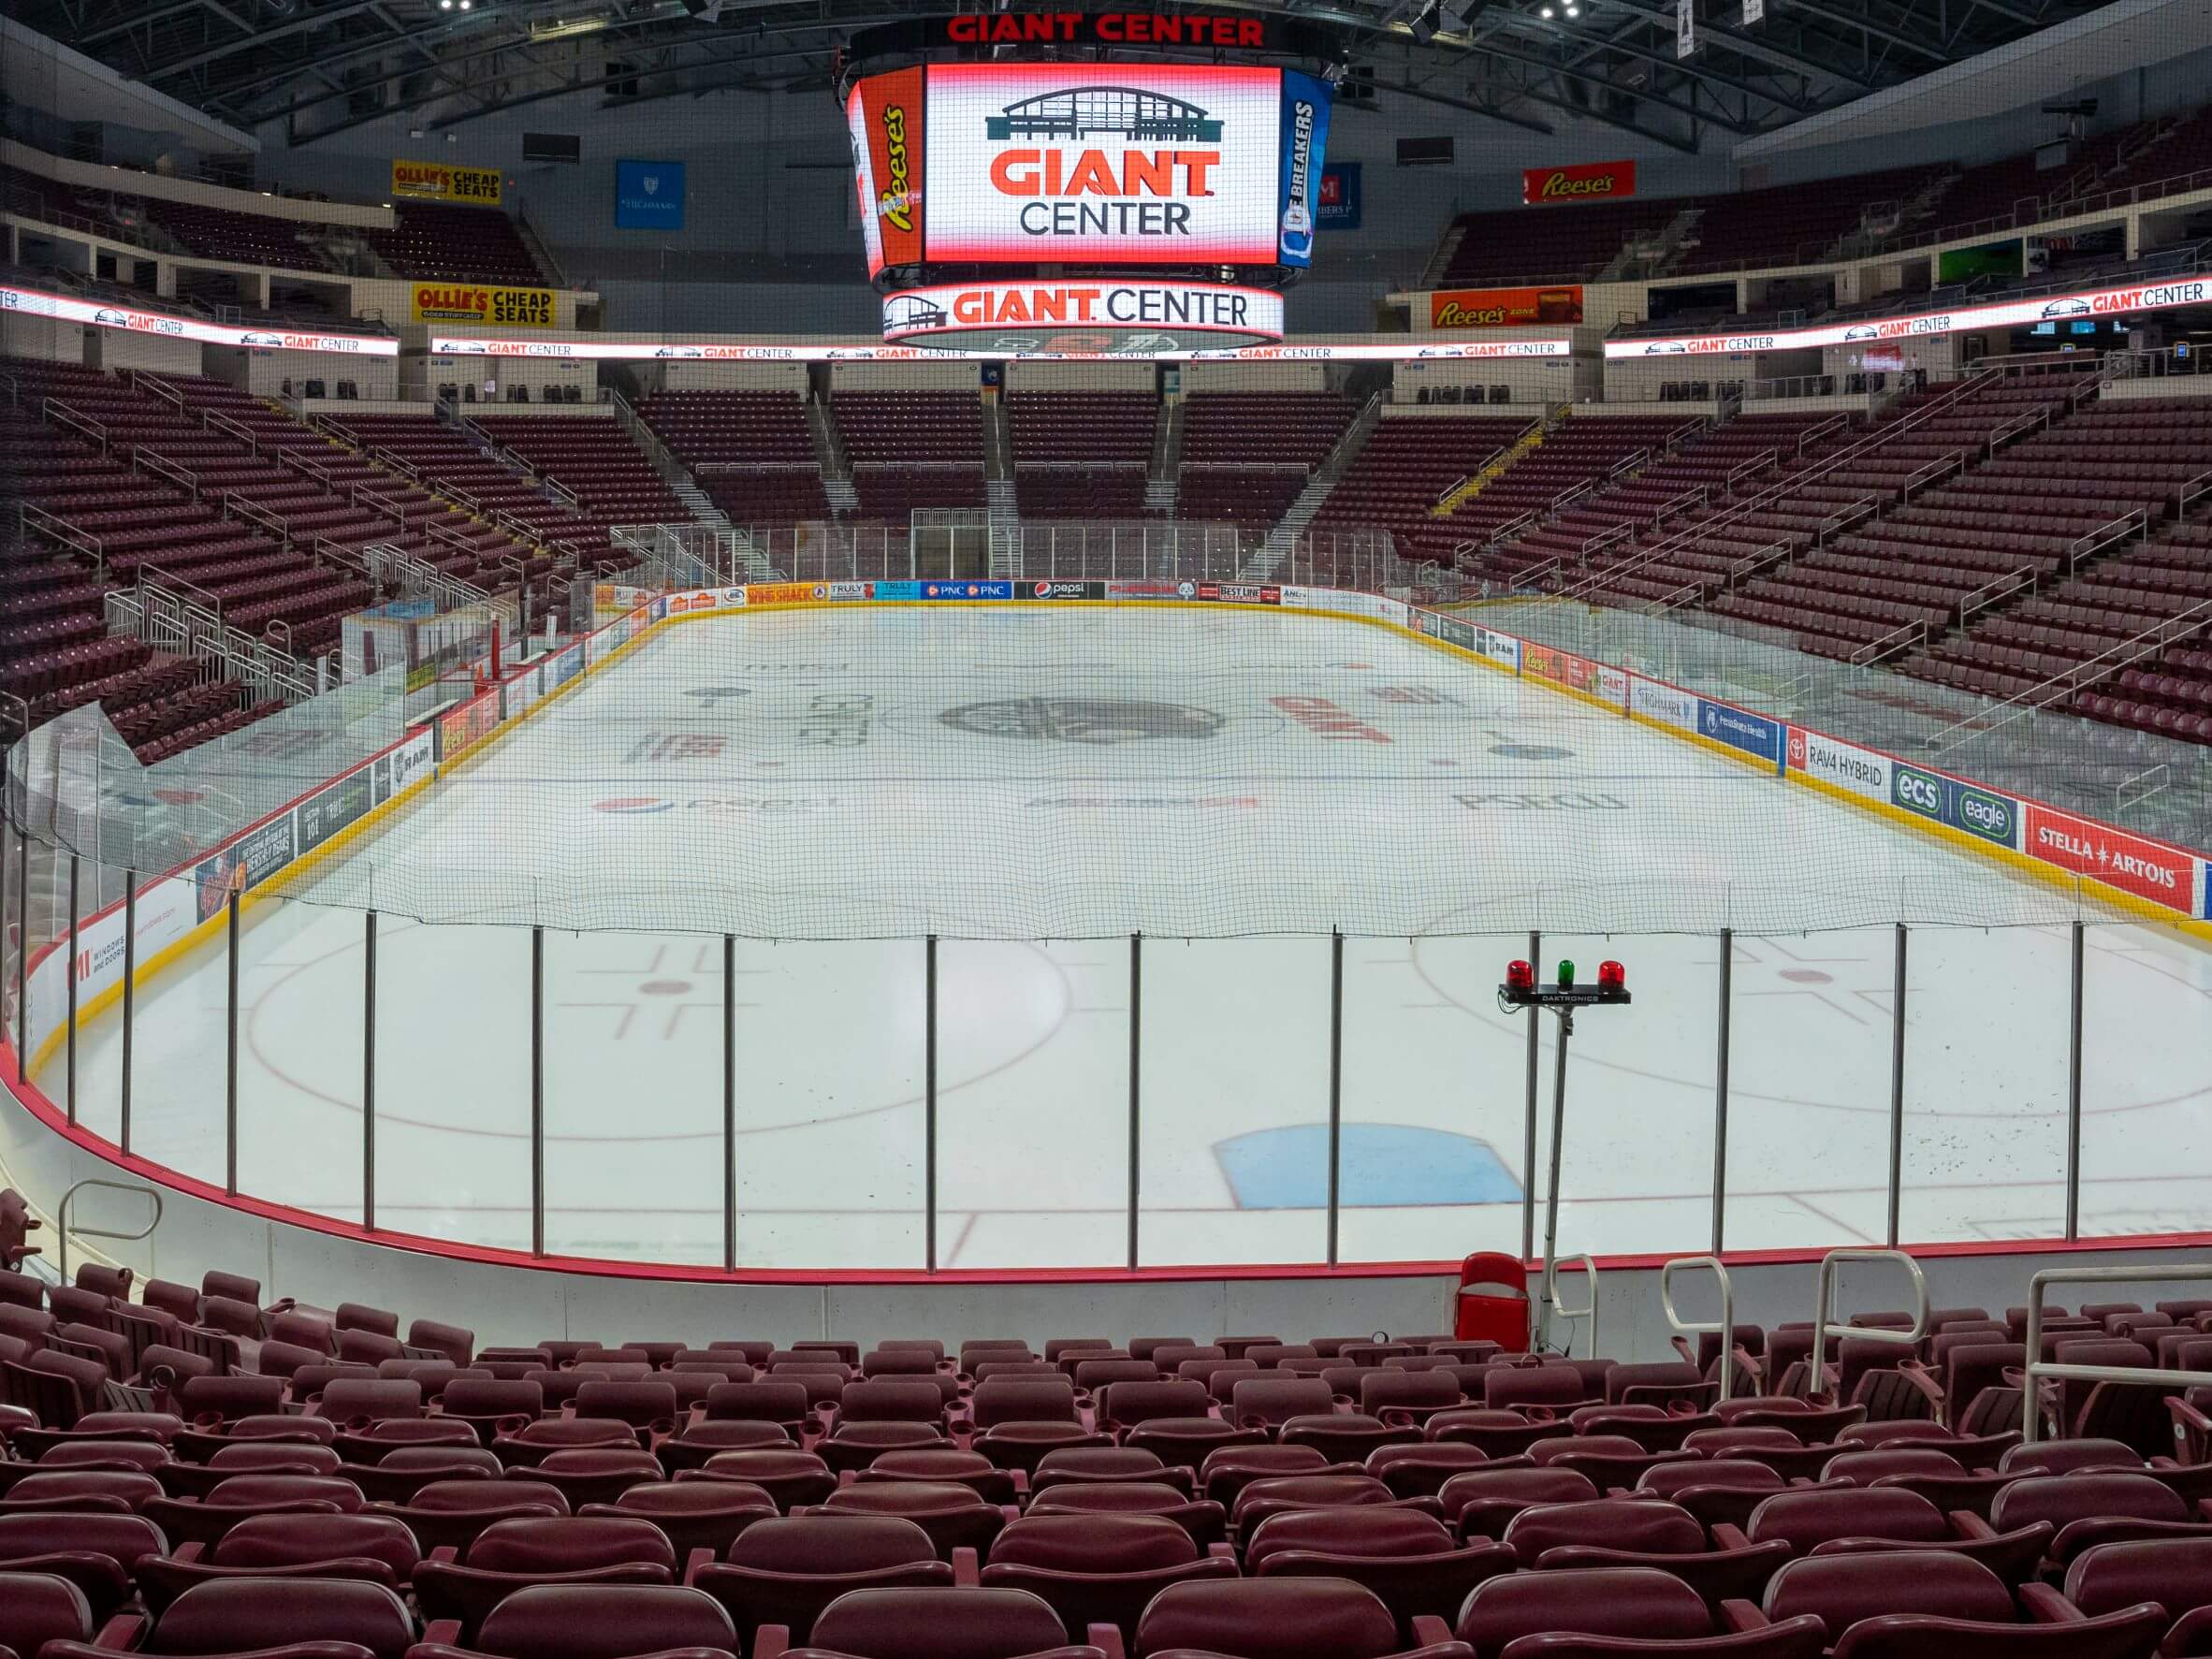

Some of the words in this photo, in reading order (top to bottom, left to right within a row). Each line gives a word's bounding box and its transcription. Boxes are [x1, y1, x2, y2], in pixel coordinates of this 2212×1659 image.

[947, 14, 1083, 42] GIANT
[1096, 15, 1263, 46] CENTER
[1290, 101, 1314, 197] BREAKERS
[453, 171, 499, 187] CHEAP
[990, 150, 1220, 196] GIANT
[454, 184, 498, 198] SEATS
[1542, 172, 1615, 196] Reese's
[1021, 202, 1190, 235] CENTER
[417, 289, 488, 312] OLLIE'S
[493, 292, 551, 309] CHEAP
[2093, 291, 2142, 311] GIANT
[2144, 283, 2203, 306] CENTER
[494, 307, 550, 324] SEATS
[953, 289, 1100, 324] GIANT
[1107, 288, 1248, 327] CENTER
[1437, 302, 1506, 326] Reese's
[128, 314, 154, 329] GIANT
[155, 318, 183, 334] CENTER
[1879, 320, 1912, 338] GIANT
[1912, 315, 1951, 333] CENTER
[284, 336, 320, 348] GIANT
[321, 338, 359, 351] CENTER
[488, 343, 527, 354] GIANT
[529, 344, 571, 355] CENTER
[705, 348, 746, 358] GIANT
[747, 348, 793, 358] CENTER
[876, 348, 919, 358] GIANT
[920, 349, 967, 358] CENTER
[1239, 348, 1281, 358] GIANT
[1283, 347, 1332, 358] CENTER
[1464, 345, 1506, 356] GIANT
[1508, 343, 1555, 355] CENTER
[1688, 340, 1727, 353] GIANT
[1728, 337, 1774, 350] CENTER
[831, 584, 863, 593] TRULY
[883, 582, 912, 590] TRULY
[941, 587, 963, 596] PNC
[981, 586, 1004, 594] PNC
[1054, 583, 1084, 595] pepsi
[1220, 587, 1242, 596] BEST
[1243, 588, 1260, 597] LINE
[404, 746, 429, 773] RAM
[1809, 745, 1837, 770] RAV4
[1839, 757, 1883, 788] HYBRID
[1965, 797, 2005, 831] eagle
[307, 819, 319, 840] 101
[2039, 824, 2094, 861] STELLA
[2111, 851, 2176, 889] ARTOIS
[94, 935, 125, 961] WINDOWS
[105, 945, 125, 966] DOORS
